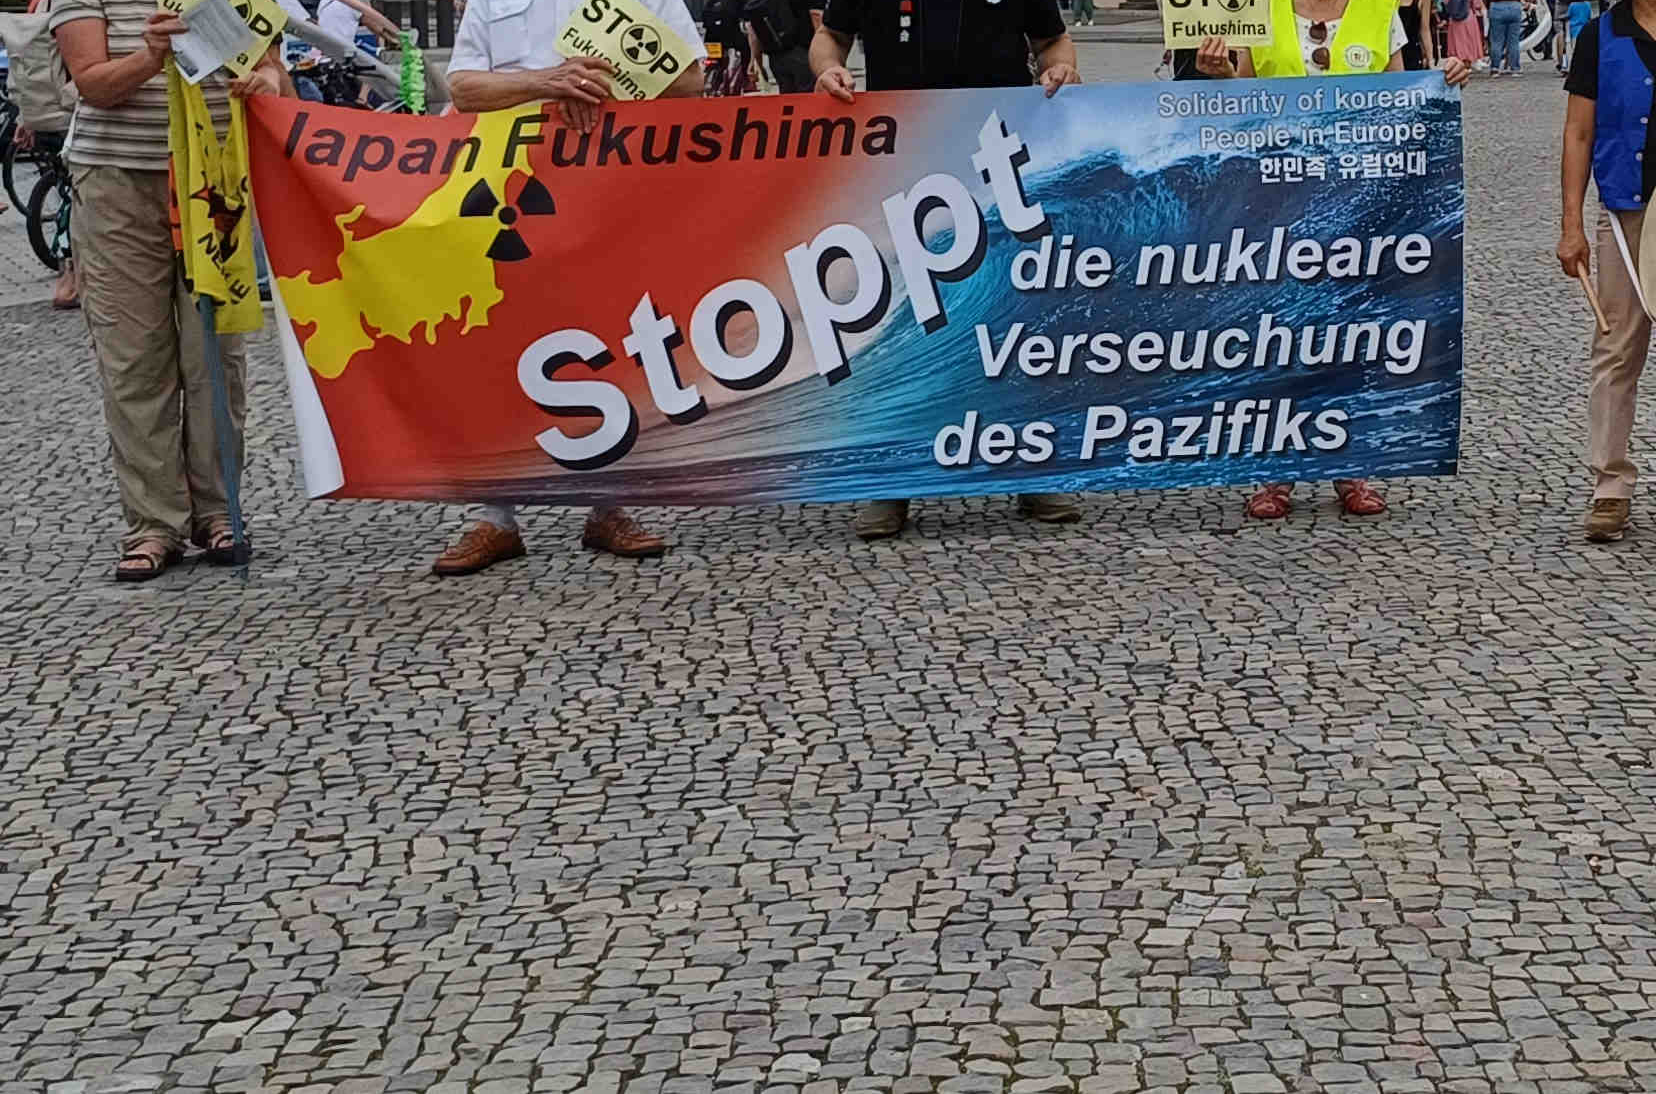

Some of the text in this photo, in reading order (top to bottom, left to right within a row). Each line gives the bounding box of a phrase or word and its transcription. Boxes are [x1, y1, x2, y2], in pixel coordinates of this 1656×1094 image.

[1172, 20, 1266, 37] Fukushima
[1158, 86, 1428, 117] Solidarity of korean
[284, 105, 899, 181] Japan Fukushima
[1200, 120, 1428, 152] People in Europe
[1258, 150, 1428, 184] 한민족 유럽연대
[516, 107, 1050, 468] Stoppt
[1010, 225, 1432, 292] die nukleare
[974, 312, 1428, 377] Verseuchung
[933, 396, 1350, 466] des Pazifiks
